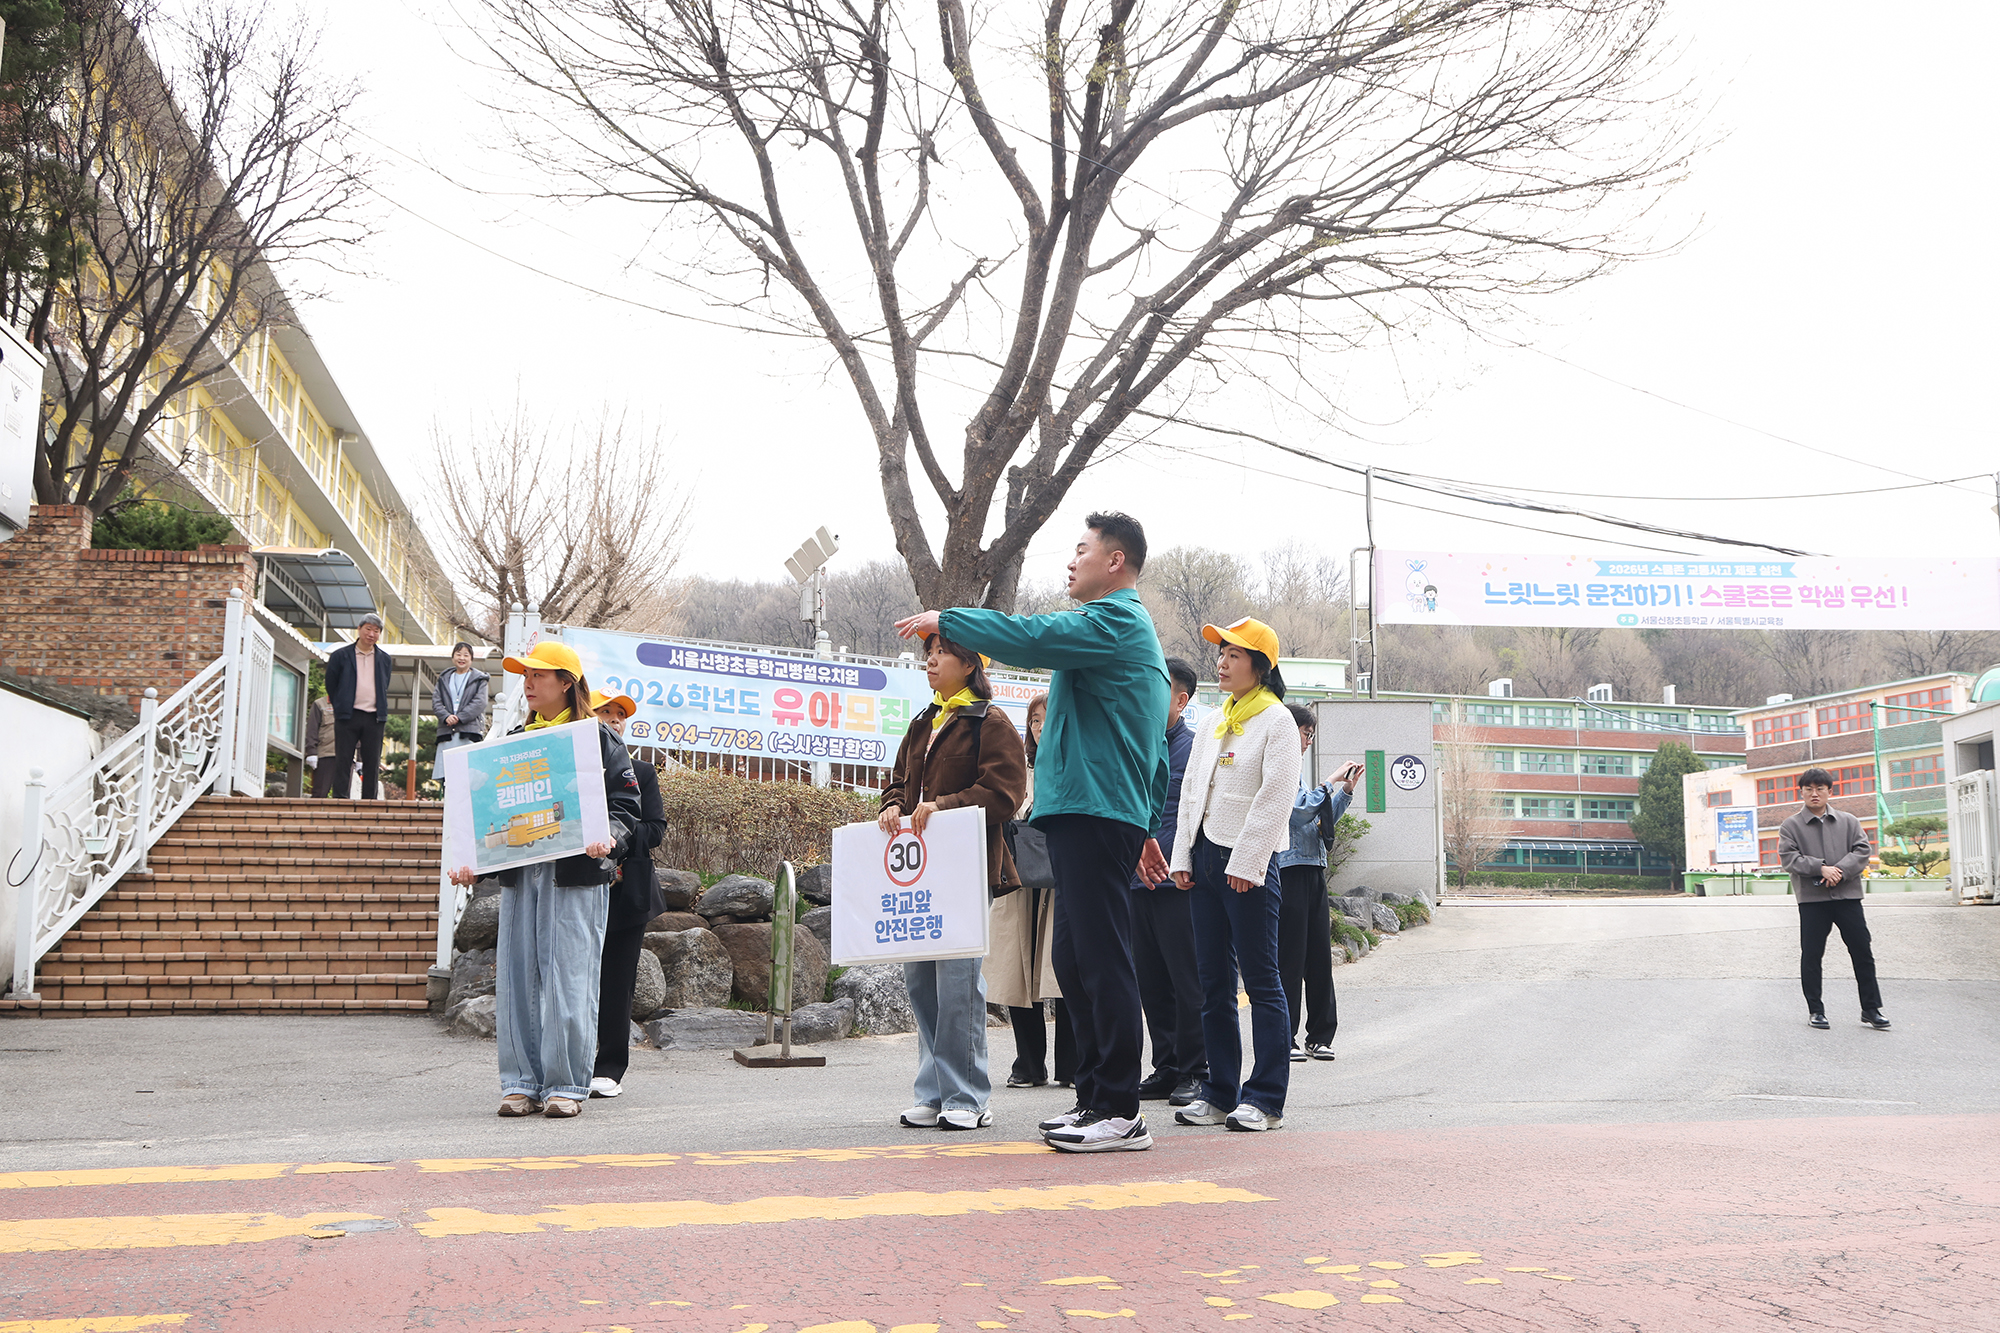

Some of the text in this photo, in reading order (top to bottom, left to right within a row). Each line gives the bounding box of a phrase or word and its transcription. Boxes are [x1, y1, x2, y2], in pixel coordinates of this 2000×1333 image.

[1608, 564, 1783, 576] 2026년 스쿨존 교통사고 제로 실천
[1484, 581, 1580, 606] 느릿느릿
[1700, 584, 1793, 608] 스쿨존은
[1798, 585, 1845, 608] 학생
[1641, 615, 1708, 626] 서울신창초등학교
[1717, 616, 1784, 626] 서울특별시교육청
[668, 648, 860, 687] 서울신창초등학교병설유치원
[605, 675, 911, 736] 2026학년도 유아모집
[656, 721, 887, 762] 994-7782 (수시상담환영)
[495, 757, 551, 788] 스쿨존
[1401, 769, 1416, 780] 93
[496, 778, 553, 809] 캠페인
[889, 841, 921, 873] 30
[880, 889, 932, 916] 학교앞
[874, 914, 943, 944] 안전운행
